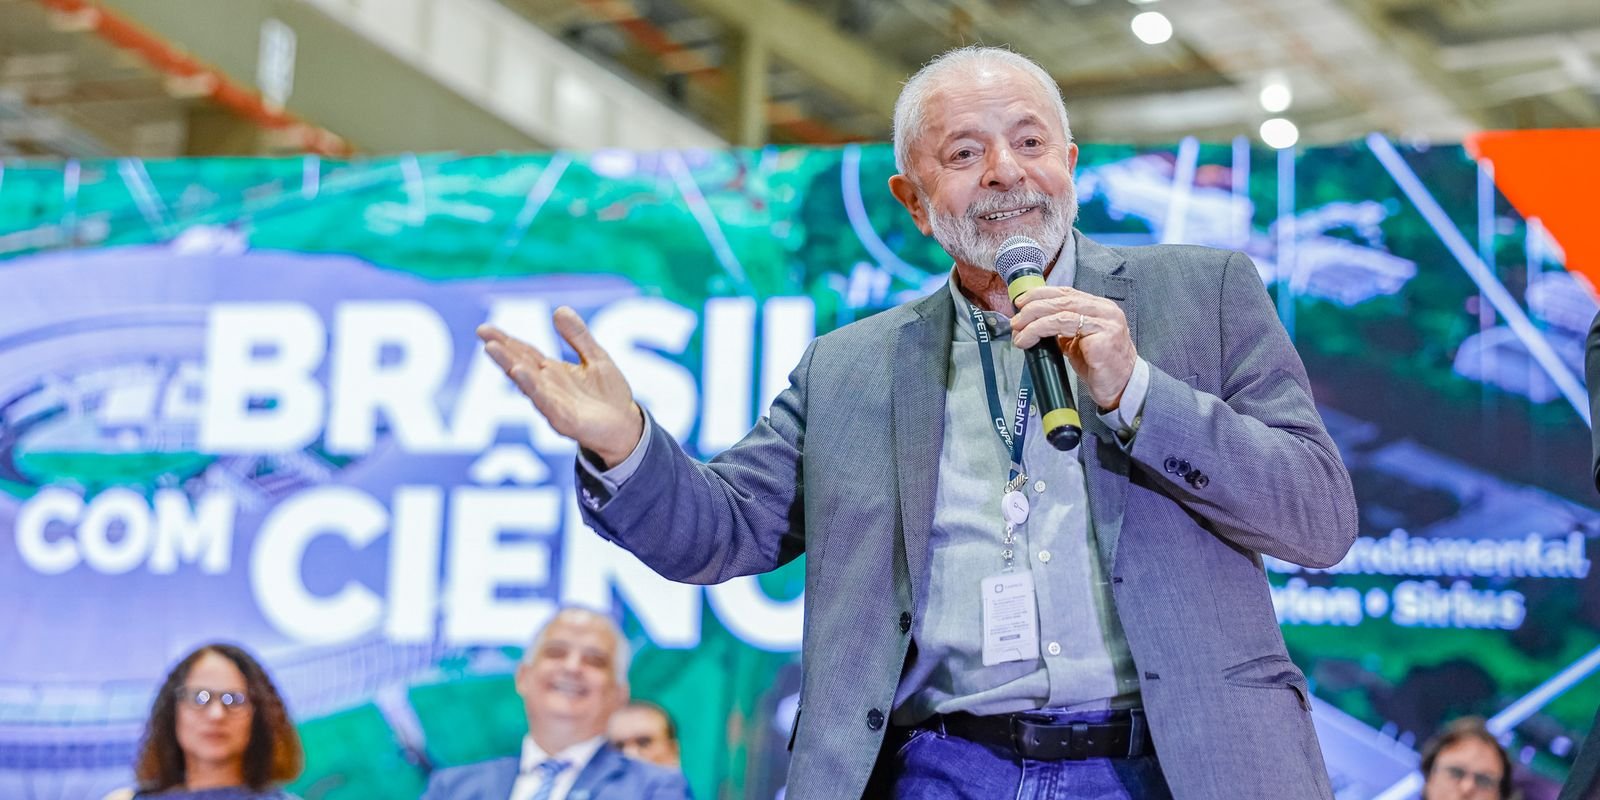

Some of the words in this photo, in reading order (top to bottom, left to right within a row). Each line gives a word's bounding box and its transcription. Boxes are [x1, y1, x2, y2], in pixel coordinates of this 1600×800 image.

[1014, 388, 1029, 436] CNPEM
[14, 485, 236, 575] COM
[1392, 580, 1526, 630] Sirius
